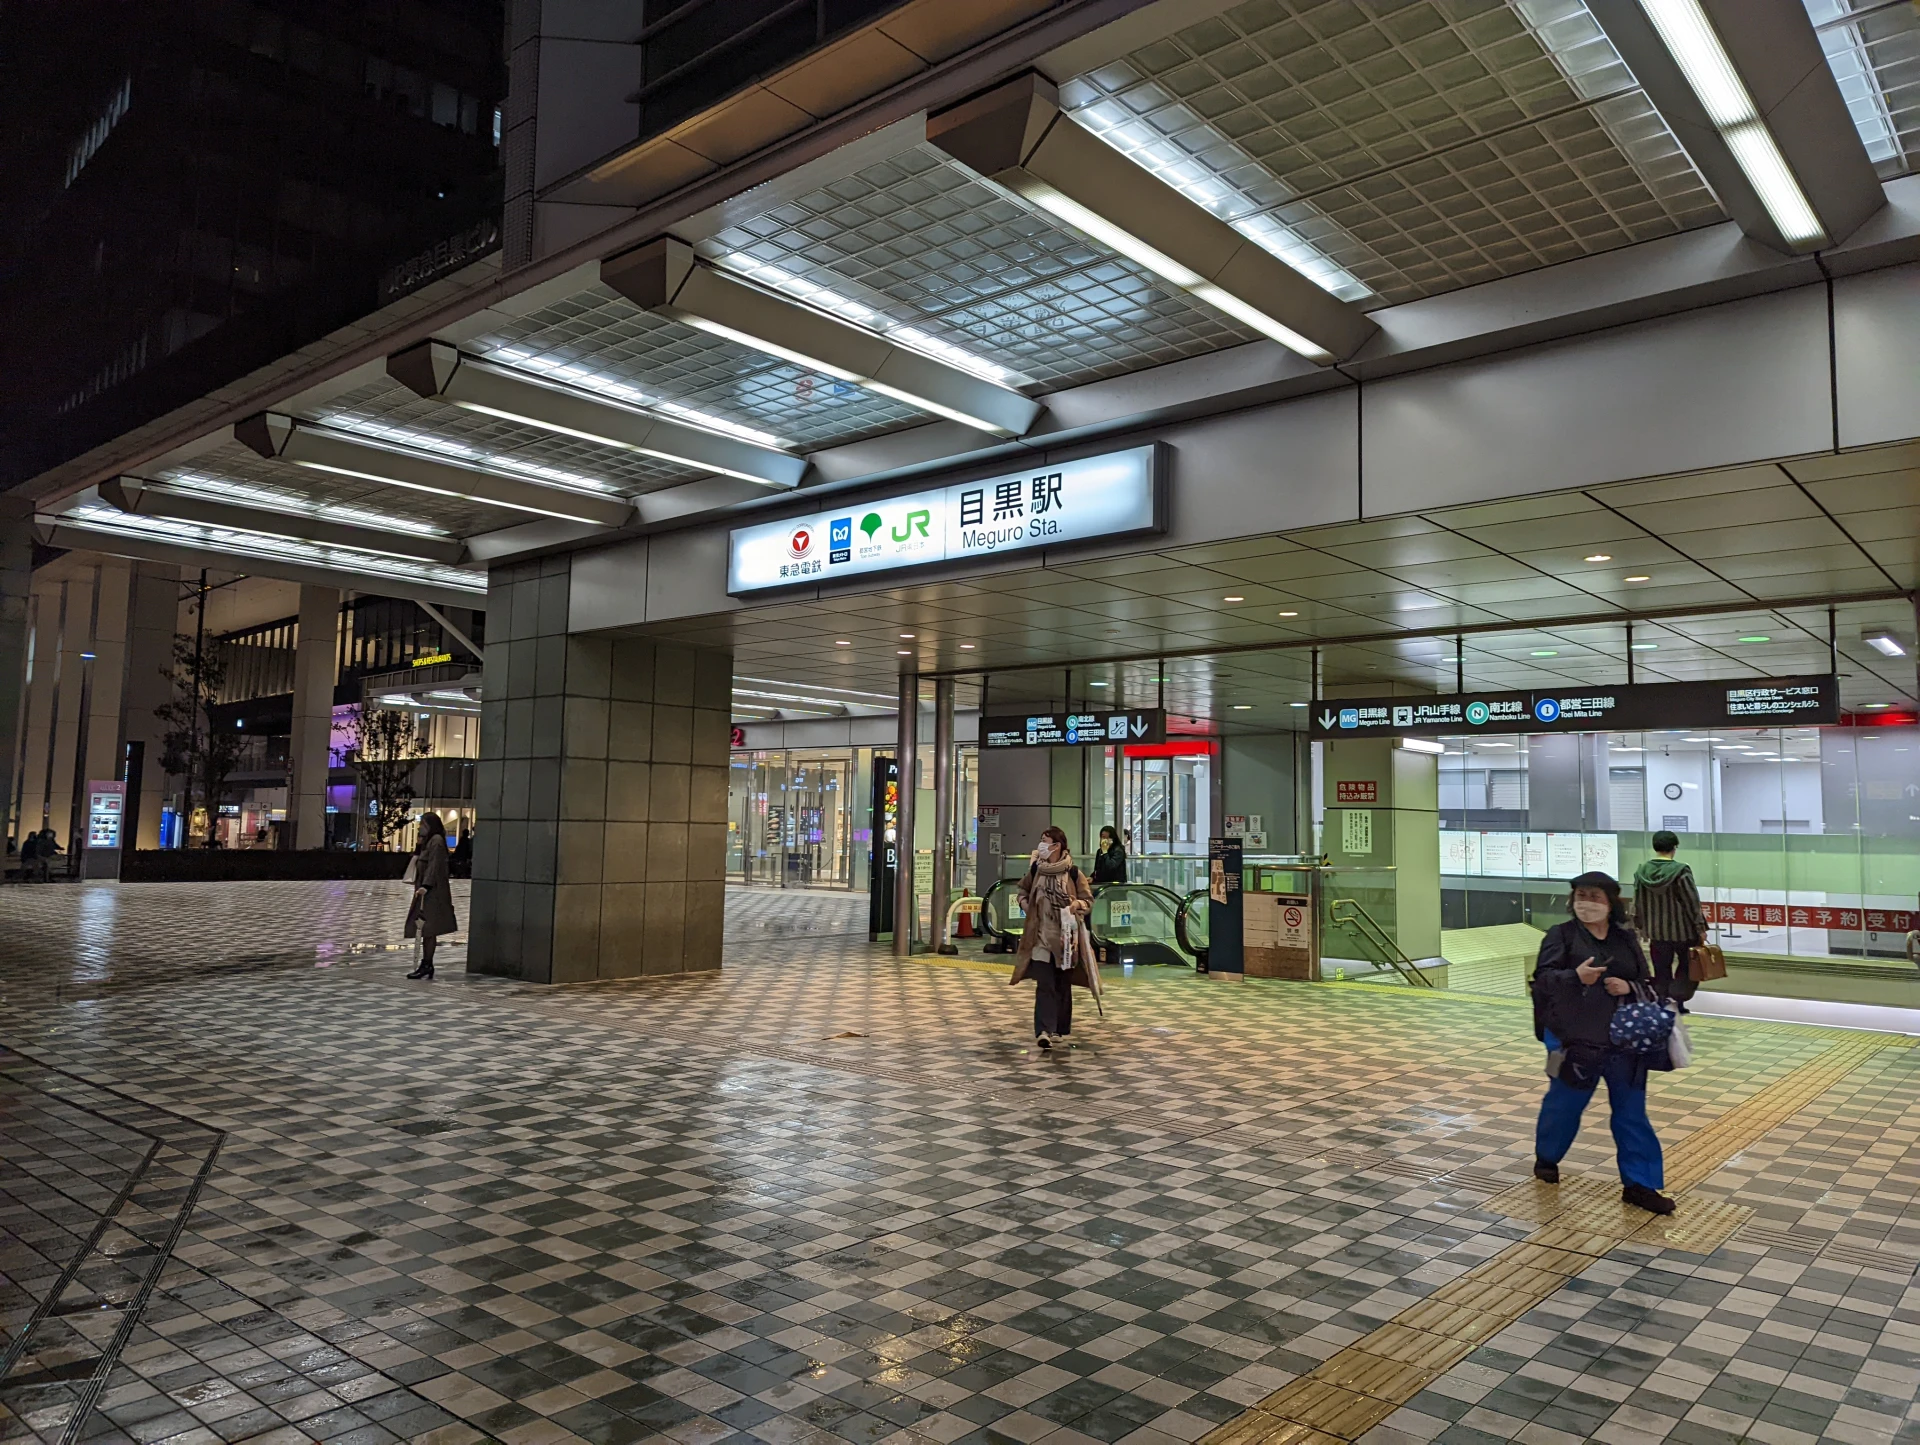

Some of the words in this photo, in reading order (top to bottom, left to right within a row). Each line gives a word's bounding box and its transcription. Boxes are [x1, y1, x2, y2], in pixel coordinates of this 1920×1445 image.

[960, 472, 1063, 528] 目黒駅
[892, 509, 930, 543] JR
[962, 525, 1024, 550] Meguro
[1029, 518, 1063, 538] Sta.
[779, 559, 822, 578] 東急電鉄
[1729, 686, 1819, 698] 目黒区行政サービス窓口
[1489, 701, 1523, 713] 南北線
[1559, 696, 1615, 710] 都営三田線
[1729, 700, 1820, 711] 住まいと暮らしのコンシェルジュ
[1359, 707, 1387, 718] 目黒線
[1414, 704, 1461, 716] JR山手線
[1473, 709, 1482, 717] N
[1341, 714, 1357, 723] MG
[1359, 719, 1378, 727] Meguro
[1379, 718, 1390, 726] Line
[1422, 716, 1451, 724] Yamanote
[1489, 713, 1518, 721] Namboku
